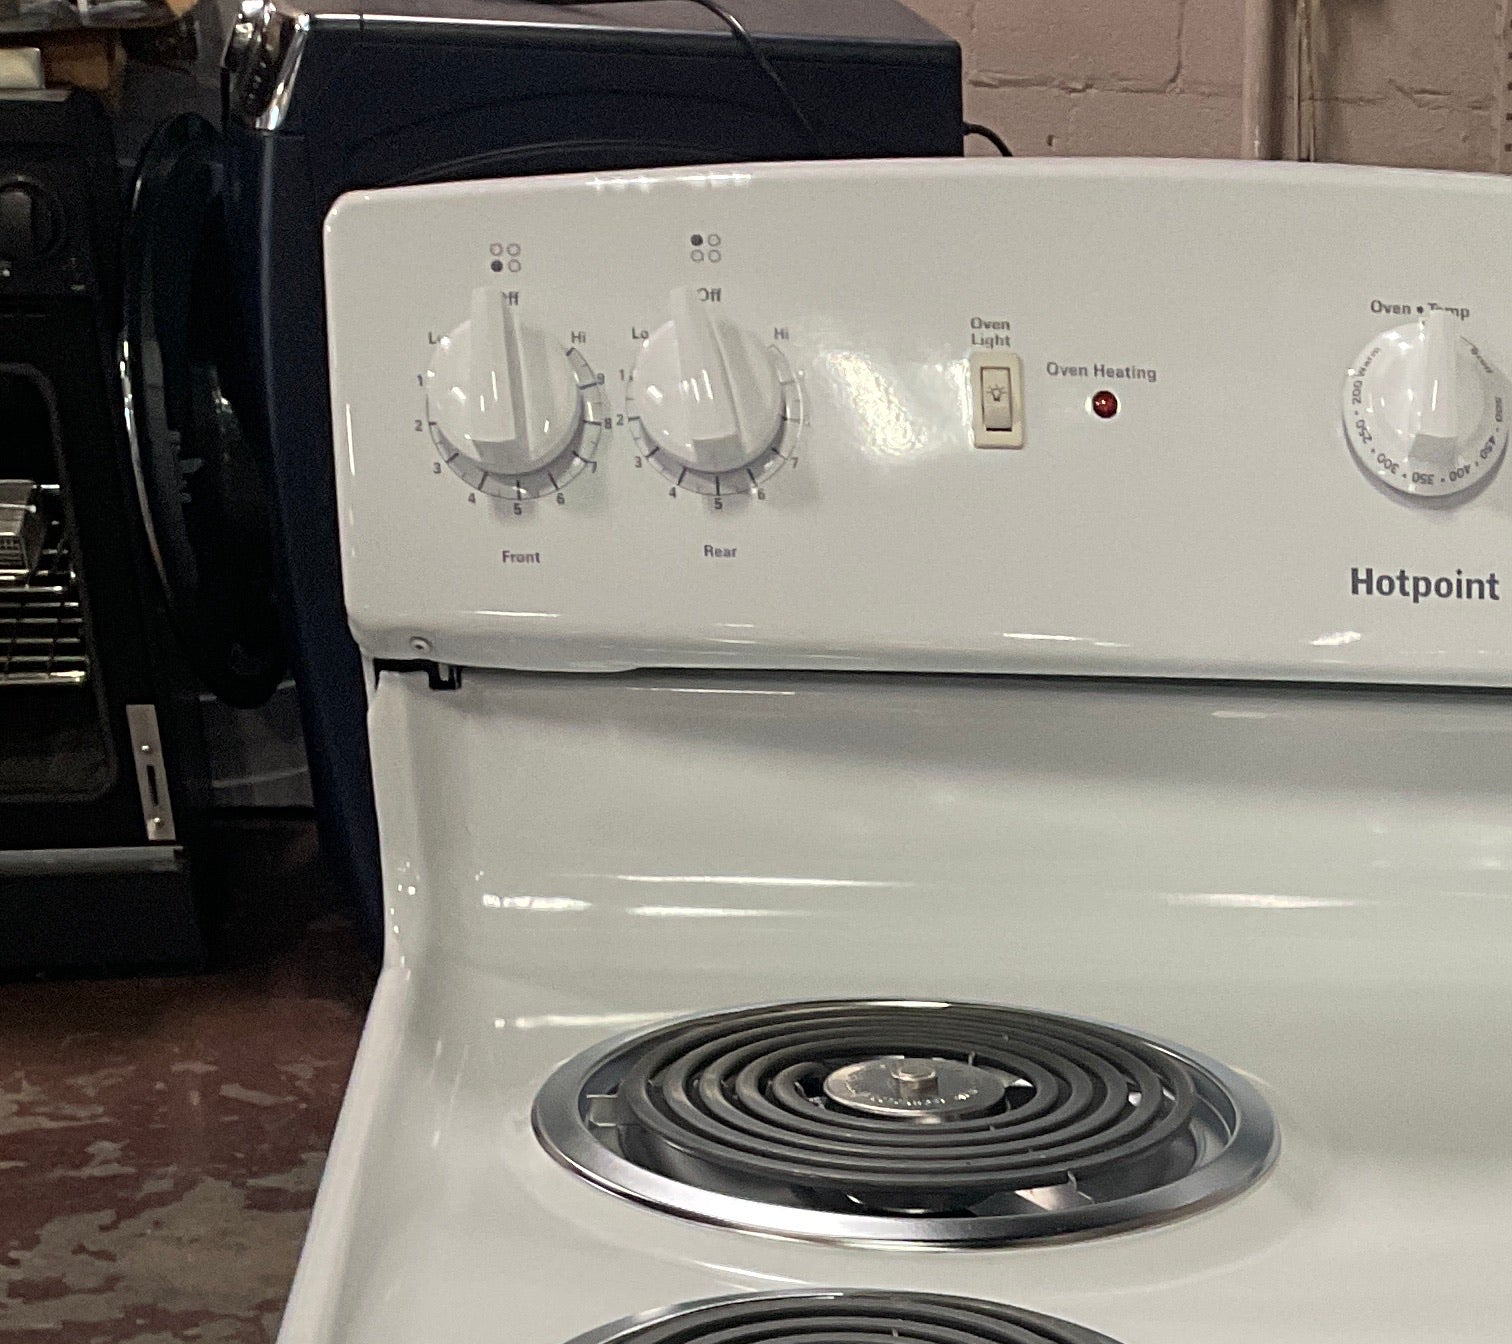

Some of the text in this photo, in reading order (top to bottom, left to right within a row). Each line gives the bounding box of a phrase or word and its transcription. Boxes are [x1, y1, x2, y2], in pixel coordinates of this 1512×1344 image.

[697, 287, 721, 302] Off
[1371, 300, 1411, 315] Oven
[971, 317, 1010, 331] Oven
[571, 331, 586, 344] Hi
[971, 333, 1011, 349] Light
[597, 373, 605, 385] 9
[1047, 362, 1157, 383] Oven Heating
[417, 375, 423, 387] 1
[1352, 380, 1363, 405] 200
[415, 420, 422, 431] 2
[604, 418, 612, 429] 8
[616, 327, 798, 510] Lo 1 2 3 4 5 6 7 Hi
[1356, 419, 1373, 444] 250
[433, 463, 441, 474] 3
[1377, 453, 1399, 474] 300
[1412, 471, 1435, 485] 350
[1450, 464, 1471, 482] 400
[468, 493, 476, 505] 4
[557, 493, 565, 505] 6
[513, 504, 522, 515] 5
[502, 550, 540, 563] Front
[703, 544, 737, 558] Rear
[1351, 567, 1500, 604] Hotpoint
